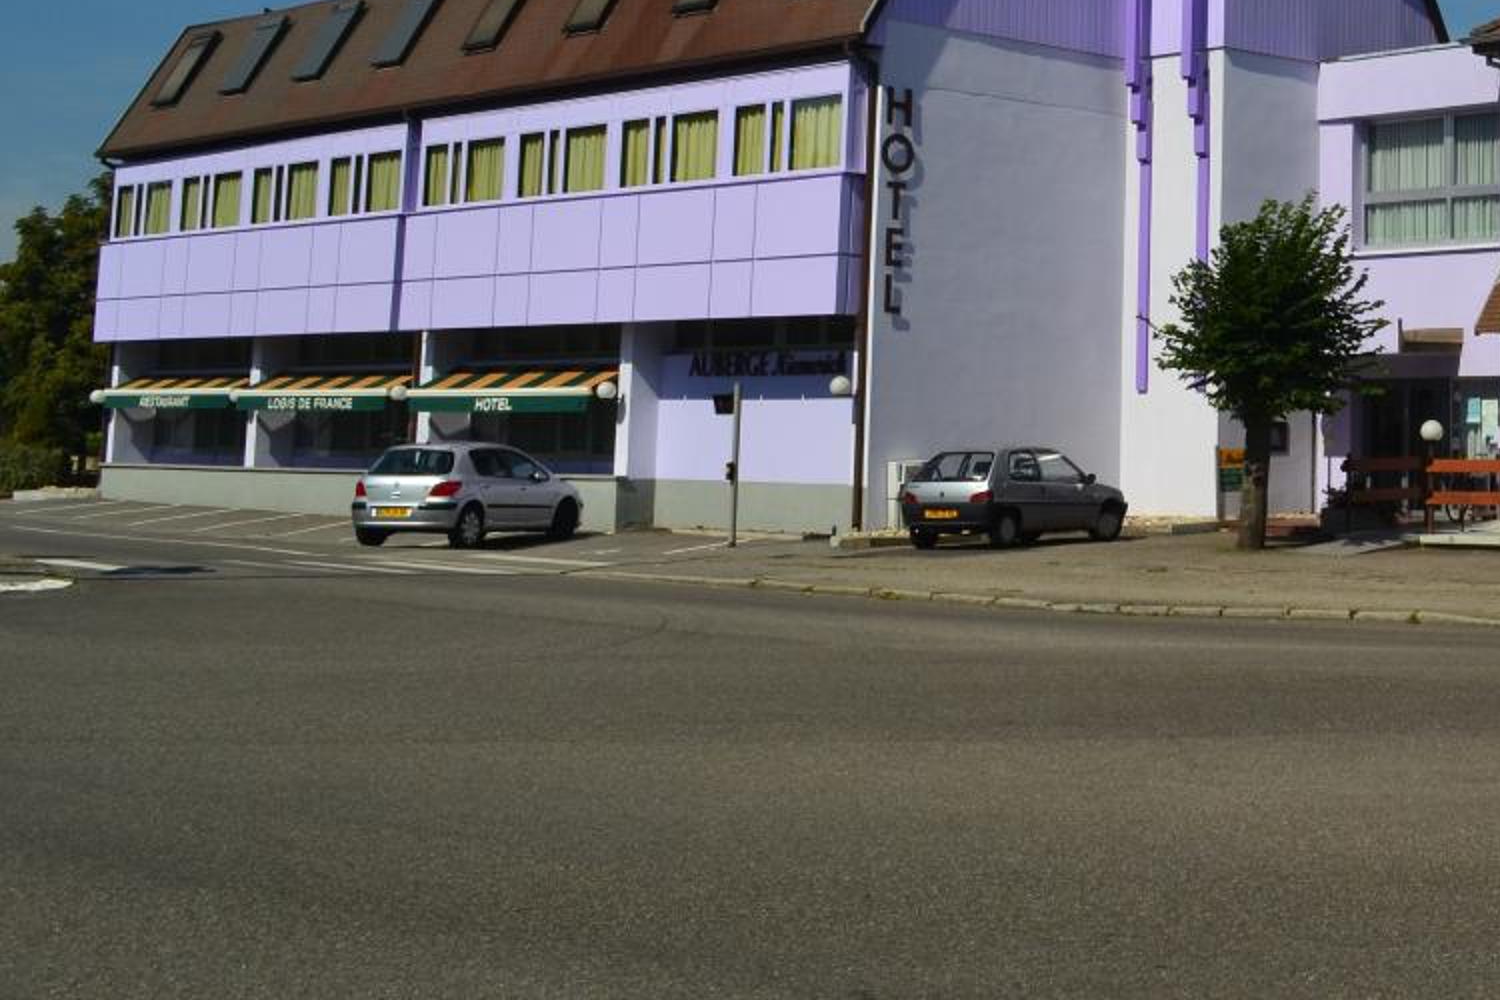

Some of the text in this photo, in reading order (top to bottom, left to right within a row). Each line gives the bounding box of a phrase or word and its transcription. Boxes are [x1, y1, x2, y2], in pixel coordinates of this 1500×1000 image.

[881, 85, 915, 315] HOTEL
[298, 397, 311, 409] DE
[313, 397, 353, 409] FRANCE
[473, 397, 513, 411] HOTEL
